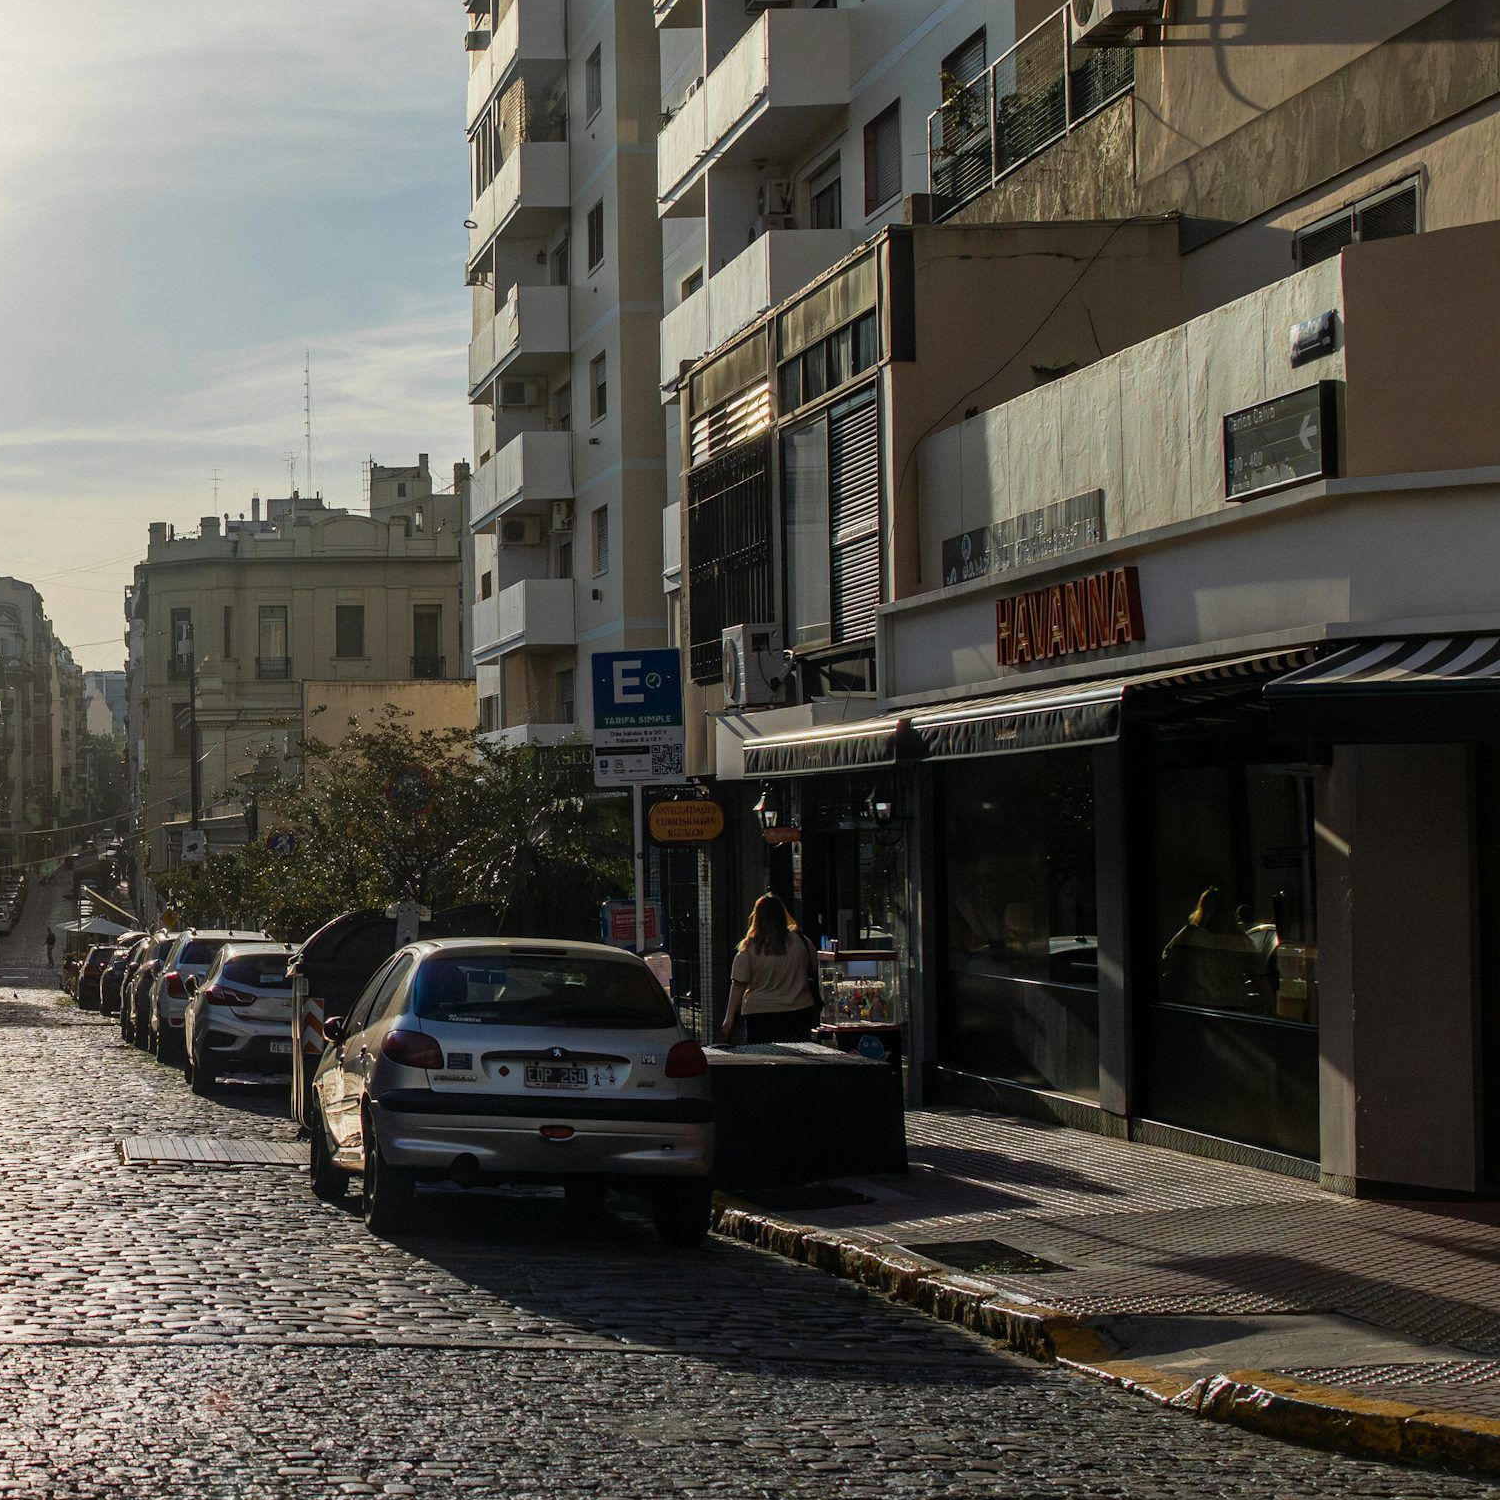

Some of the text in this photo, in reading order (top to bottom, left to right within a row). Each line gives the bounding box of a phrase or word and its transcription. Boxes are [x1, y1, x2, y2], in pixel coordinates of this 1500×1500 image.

[1228, 406, 1276, 433] Carlos Calvo
[1249, 451, 1263, 470] 400
[996, 566, 1134, 666] HAVANNA
[612, 659, 645, 704] E
[604, 714, 673, 726] TARIFA SIMPLE
[527, 1066, 552, 1082] EDP
